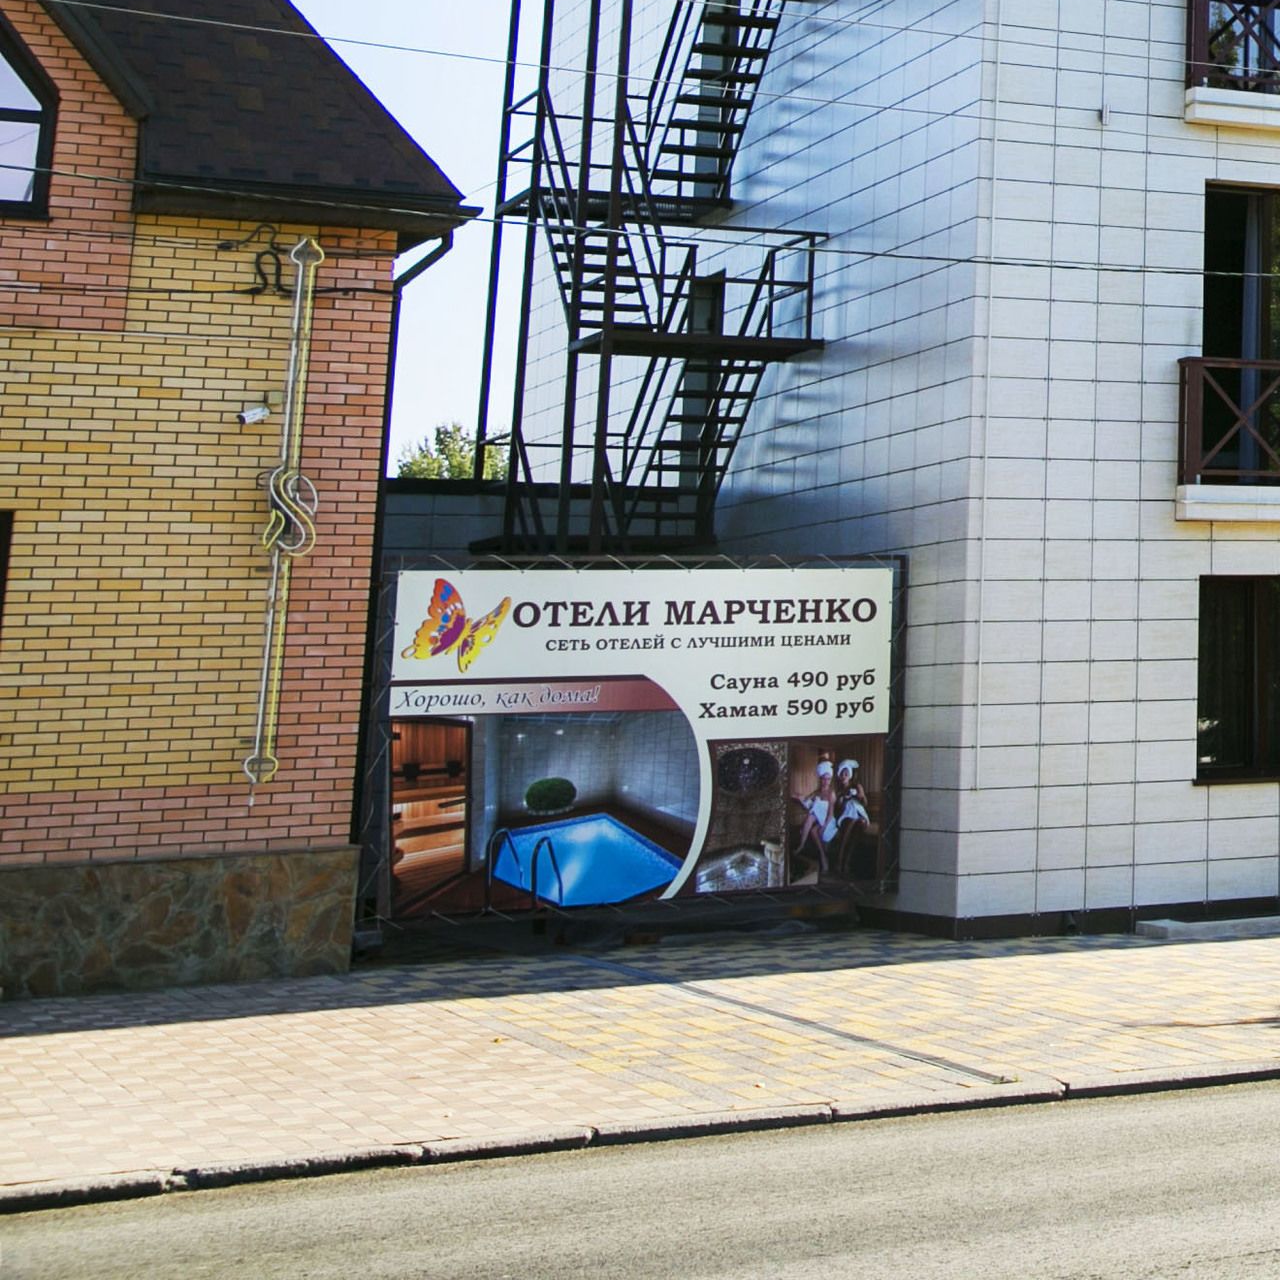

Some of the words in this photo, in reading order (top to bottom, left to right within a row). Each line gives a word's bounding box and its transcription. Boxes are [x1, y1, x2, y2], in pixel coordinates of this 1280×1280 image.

[513, 601, 650, 627] ОТЕЛИ
[664, 598, 877, 626] МАРЧЕНКО
[545, 638, 590, 651] СЕТЬ
[596, 634, 665, 651] ОТЕЛЕЙ
[670, 637, 683, 649] С
[687, 635, 775, 650] ЛУЧШИМИ
[781, 634, 851, 648] ЦЕНАМИ
[710, 674, 779, 693] Сауна
[787, 671, 829, 688] 490
[836, 669, 876, 691] руб
[395, 689, 486, 713] Хорошо,
[495, 688, 533, 707] как
[539, 685, 601, 705] дома!
[698, 702, 778, 719] Хамам
[786, 699, 828, 716] 590
[835, 696, 875, 719] руб
